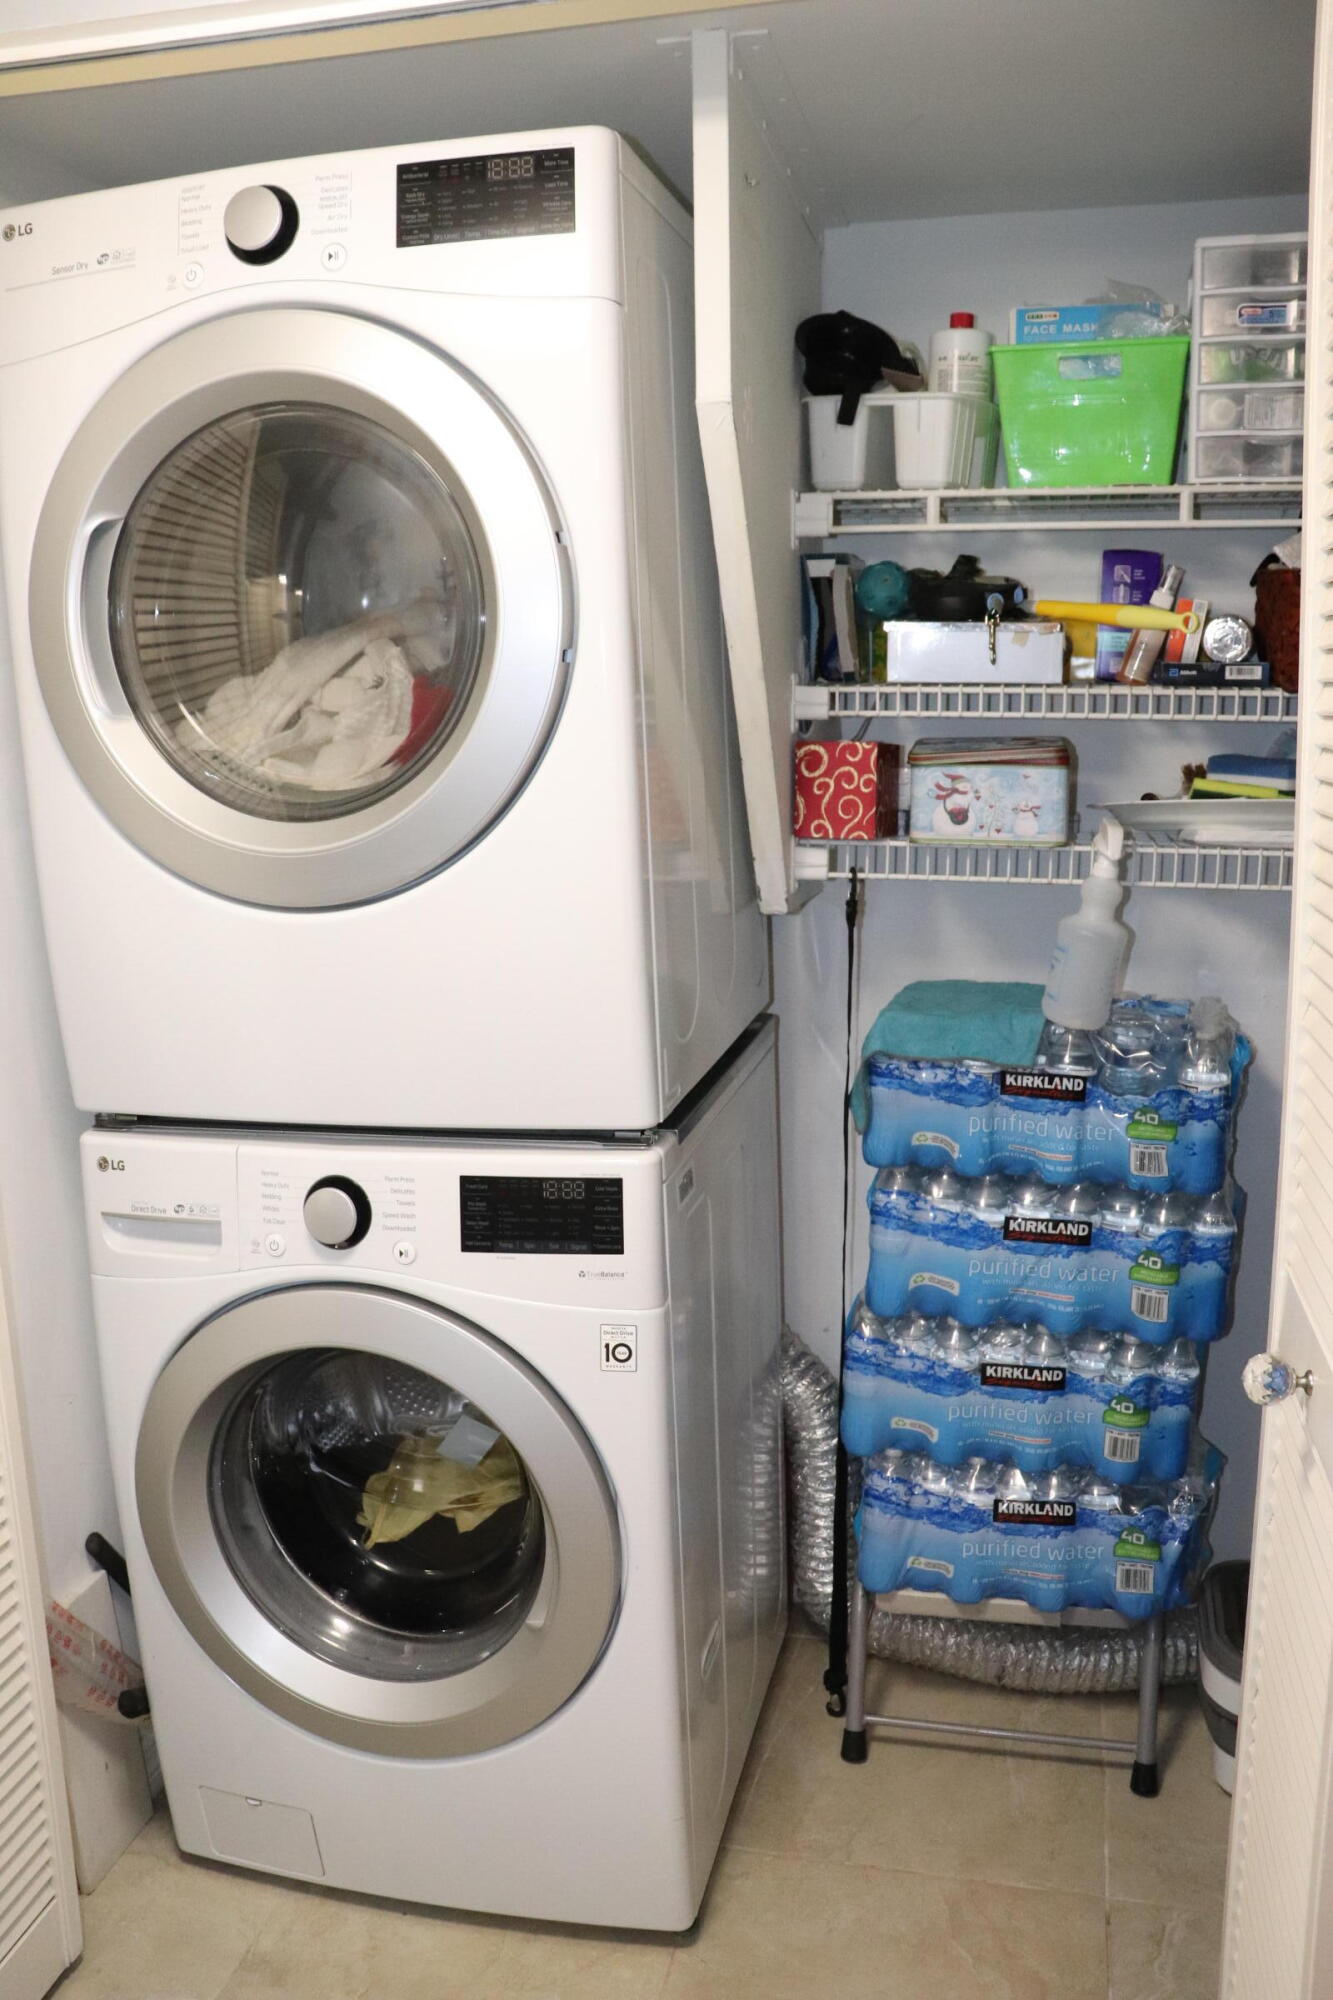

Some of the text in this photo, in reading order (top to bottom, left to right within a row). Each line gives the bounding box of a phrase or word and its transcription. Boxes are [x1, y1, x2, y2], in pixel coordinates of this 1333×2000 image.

[18, 222, 33, 237] LG
[51, 262, 88, 276] Sensor Dry
[1023, 324, 1057, 336] FACE
[1005, 1074, 1084, 1091] KIRKLAND
[1134, 1111, 1158, 1125] 40
[969, 1114, 1048, 1137] purified
[1055, 1122, 1118, 1141] water
[111, 1160, 126, 1171] LG
[131, 1205, 167, 1215] Direct Drive
[382, 1212, 400, 1220] Speed
[382, 1224, 416, 1232] Downloaded
[1008, 1219, 1090, 1236] KIRKLAND
[968, 1256, 1120, 1283] purified water
[1138, 1254, 1162, 1270] 40
[604, 1342, 632, 1363] 10
[986, 1365, 1064, 1382] KIRKLAND
[948, 1403, 1094, 1425] purified water
[1110, 1399, 1134, 1414] 40
[998, 1501, 1074, 1516] KIRKLAND
[1121, 1531, 1144, 1544] 40
[962, 1539, 1104, 1561] purified water
